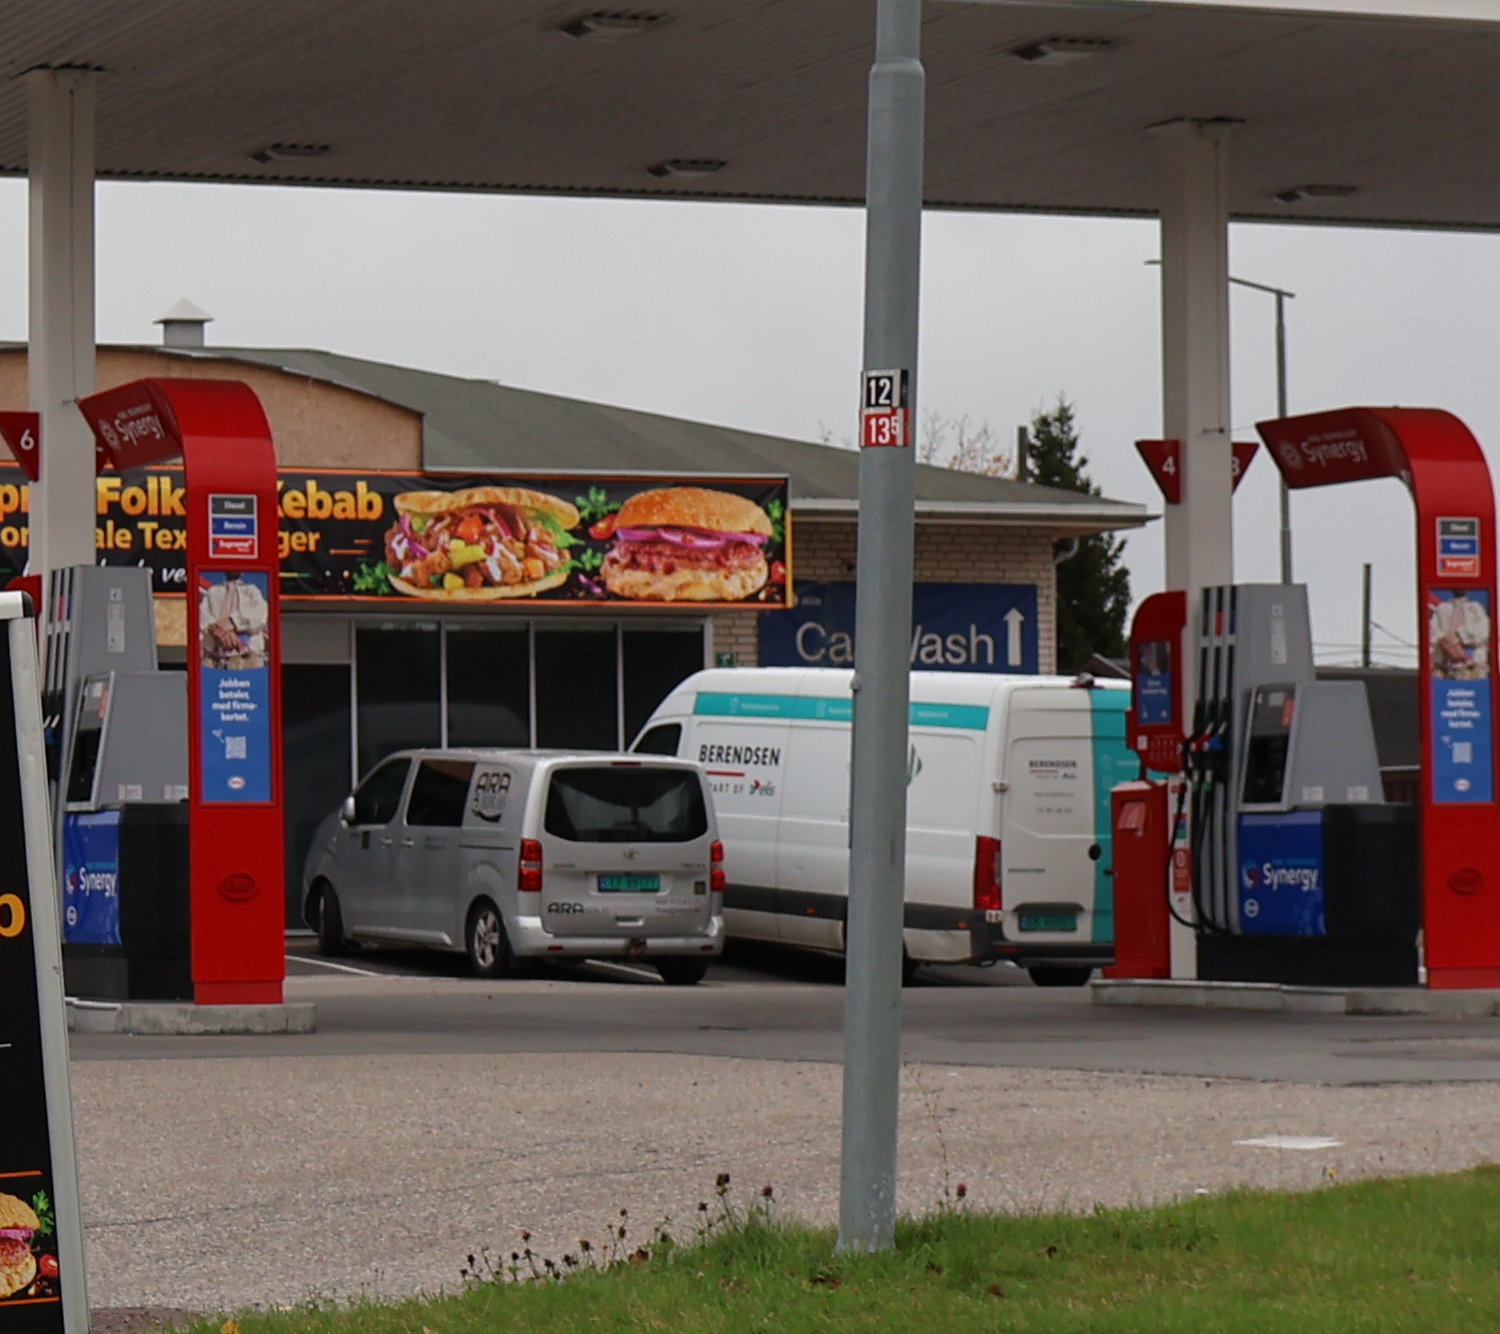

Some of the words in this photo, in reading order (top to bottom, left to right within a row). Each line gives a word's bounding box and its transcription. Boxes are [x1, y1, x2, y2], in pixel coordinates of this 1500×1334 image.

[869, 378, 891, 405] 12
[20, 433, 34, 451] 6
[114, 415, 165, 448] Synergy
[1162, 456, 1175, 475] 4
[1301, 439, 1368, 467] Synergy
[96, 477, 186, 517] Folk
[278, 478, 383, 521] ebab
[137, 522, 320, 559] Texger
[796, 621, 853, 664] Ca
[699, 744, 781, 766] BERENDSEN
[475, 772, 511, 794] ARA
[79, 867, 117, 897] Synergy
[1262, 862, 1319, 892] Synergy
[547, 902, 584, 914] ARA
